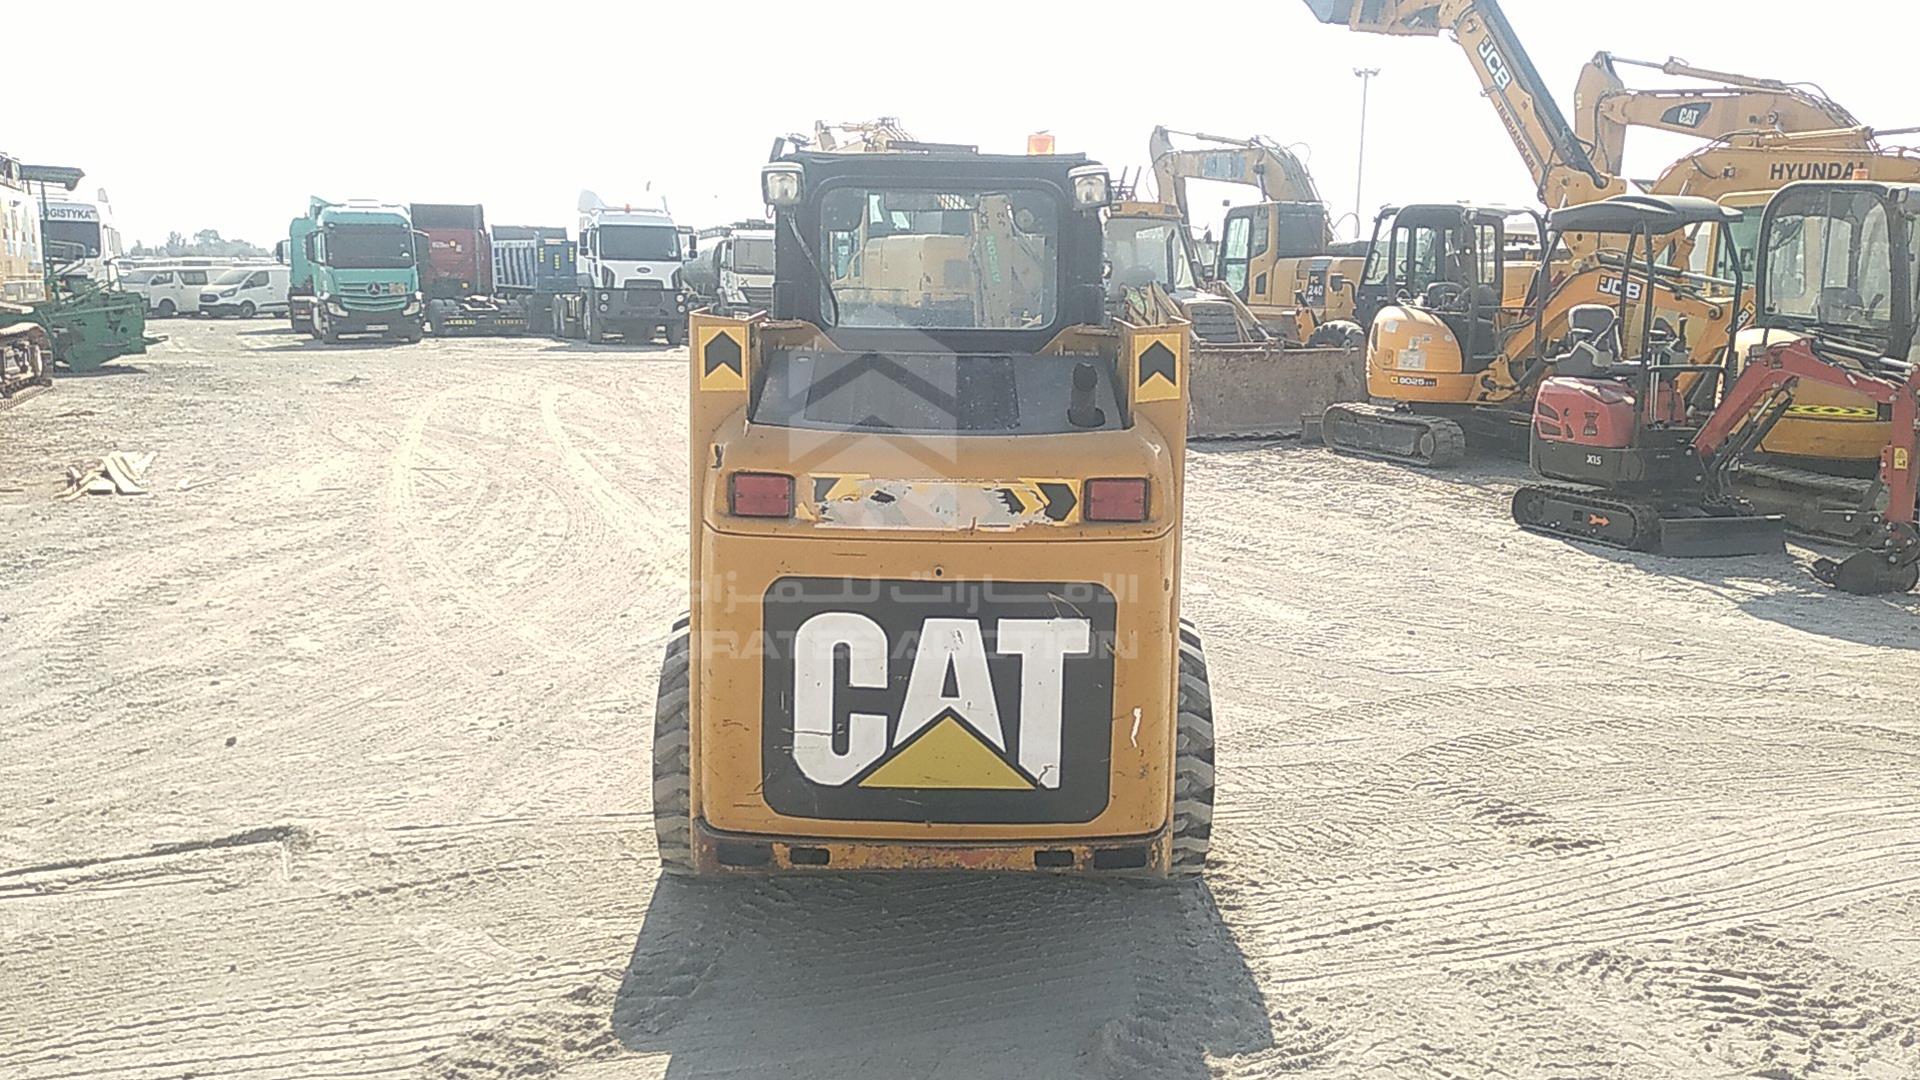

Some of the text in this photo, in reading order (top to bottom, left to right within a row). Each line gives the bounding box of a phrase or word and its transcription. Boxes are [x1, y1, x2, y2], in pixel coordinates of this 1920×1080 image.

[1479, 38, 1511, 90] JCB
[1496, 101, 1536, 171] TELEHANDLER
[1678, 107, 1700, 126] CAT
[1307, 285, 1324, 296] 240
[793, 612, 1091, 789] CAT
